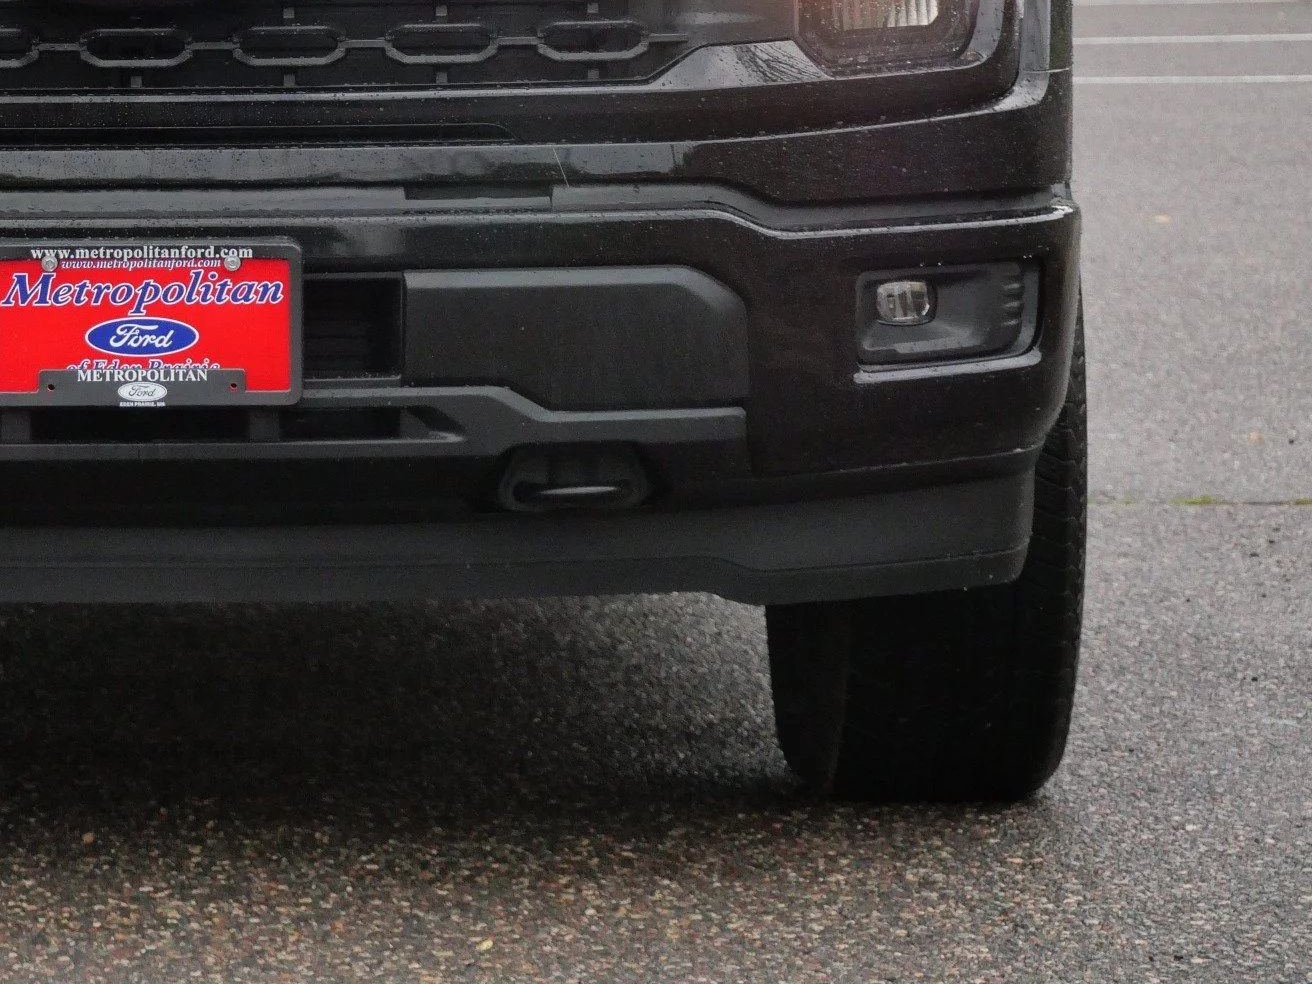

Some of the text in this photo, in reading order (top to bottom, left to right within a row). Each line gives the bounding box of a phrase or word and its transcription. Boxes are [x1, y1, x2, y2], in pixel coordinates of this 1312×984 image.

[30, 245, 253, 262] www.metropolitanford.com
[61, 258, 221, 271] www.metropolitanford.com
[0, 269, 284, 316] Metropolitan
[109, 323, 174, 348] Ford
[77, 369, 208, 382] METROPOLITAN
[128, 385, 156, 397] Ford
